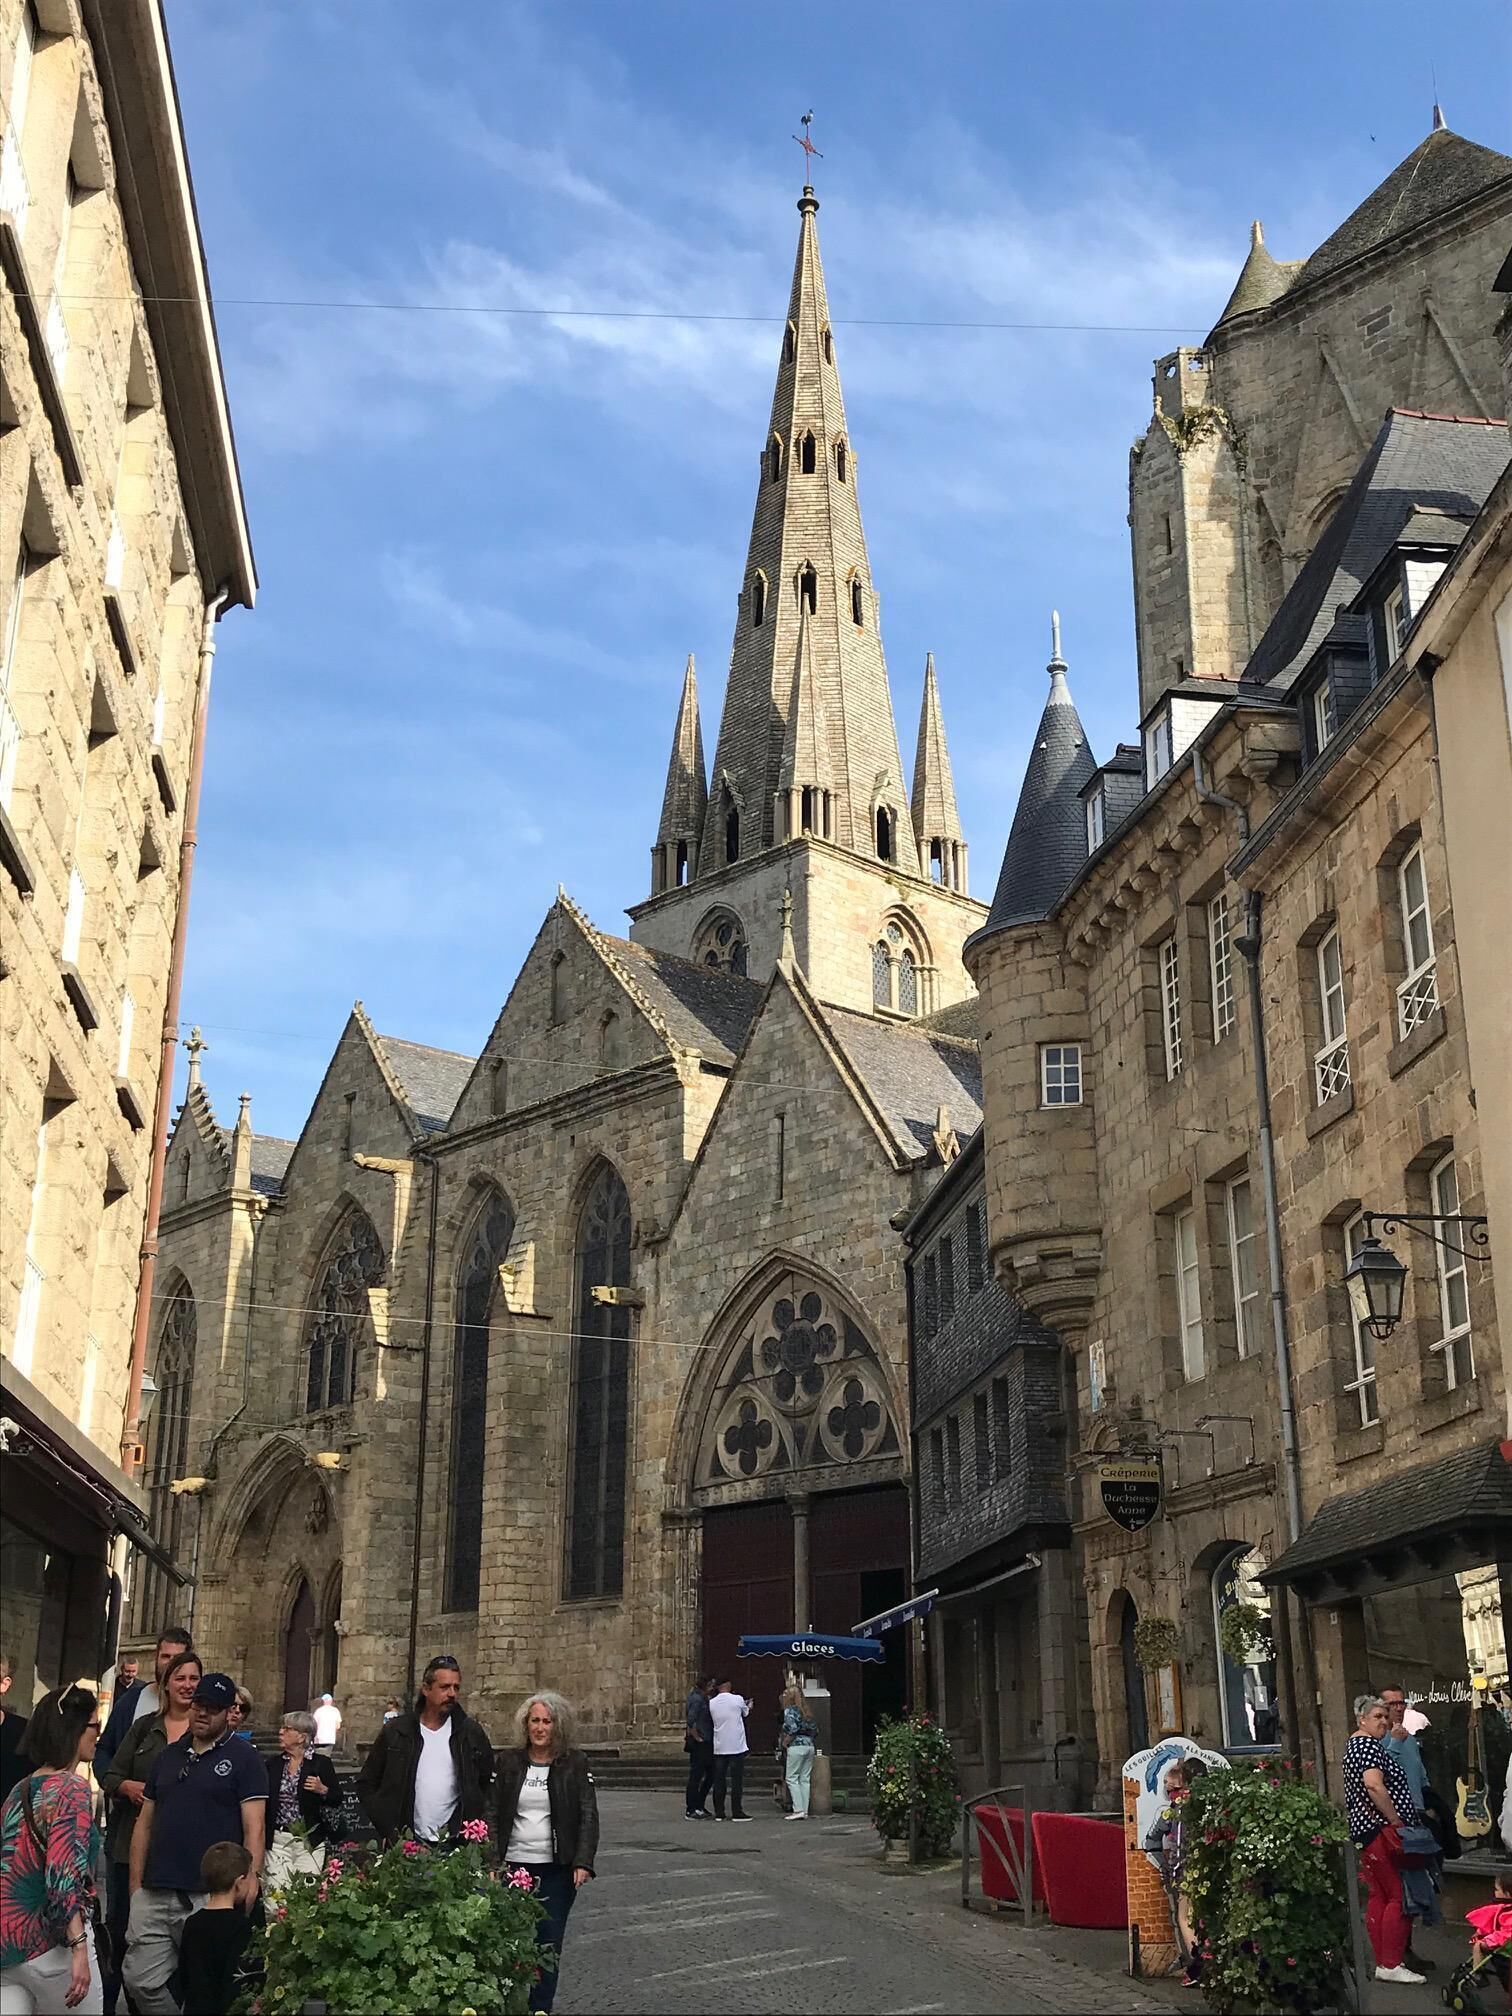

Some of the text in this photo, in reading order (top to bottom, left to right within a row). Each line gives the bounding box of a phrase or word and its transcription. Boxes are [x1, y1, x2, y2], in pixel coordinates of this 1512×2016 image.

[1101, 1467, 1158, 1479] Crêperie
[1124, 1482, 1137, 1492] La
[1104, 1492, 1158, 1503] Duchesse
[1118, 1506, 1146, 1515] Anne
[791, 1641, 835, 1654] Glaces
